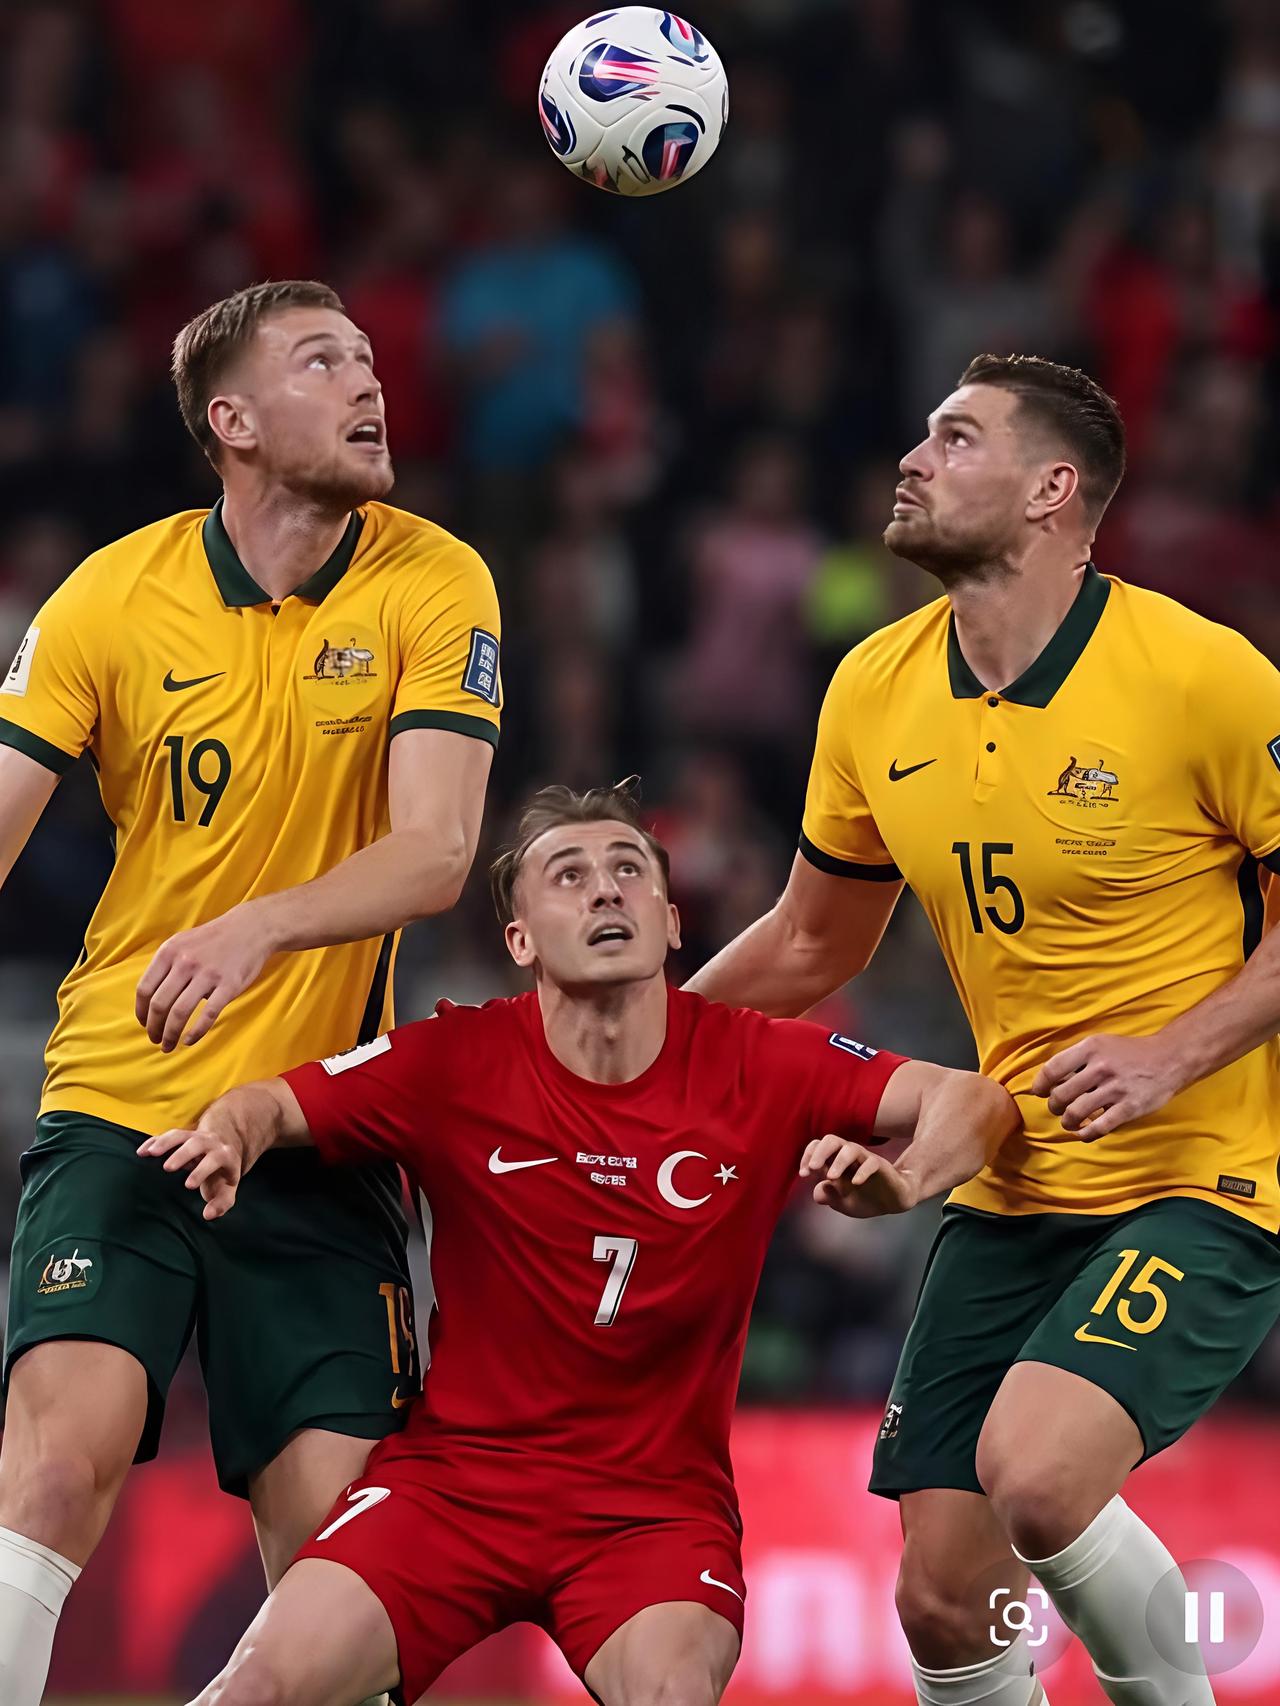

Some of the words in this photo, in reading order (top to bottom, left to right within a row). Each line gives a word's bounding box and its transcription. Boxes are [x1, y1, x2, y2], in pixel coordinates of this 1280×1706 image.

[163, 735, 232, 828] 19
[951, 841, 1026, 936] 15
[592, 1235, 638, 1328] 7
[1090, 1248, 1184, 1336] 15
[315, 1485, 392, 1542] 7
